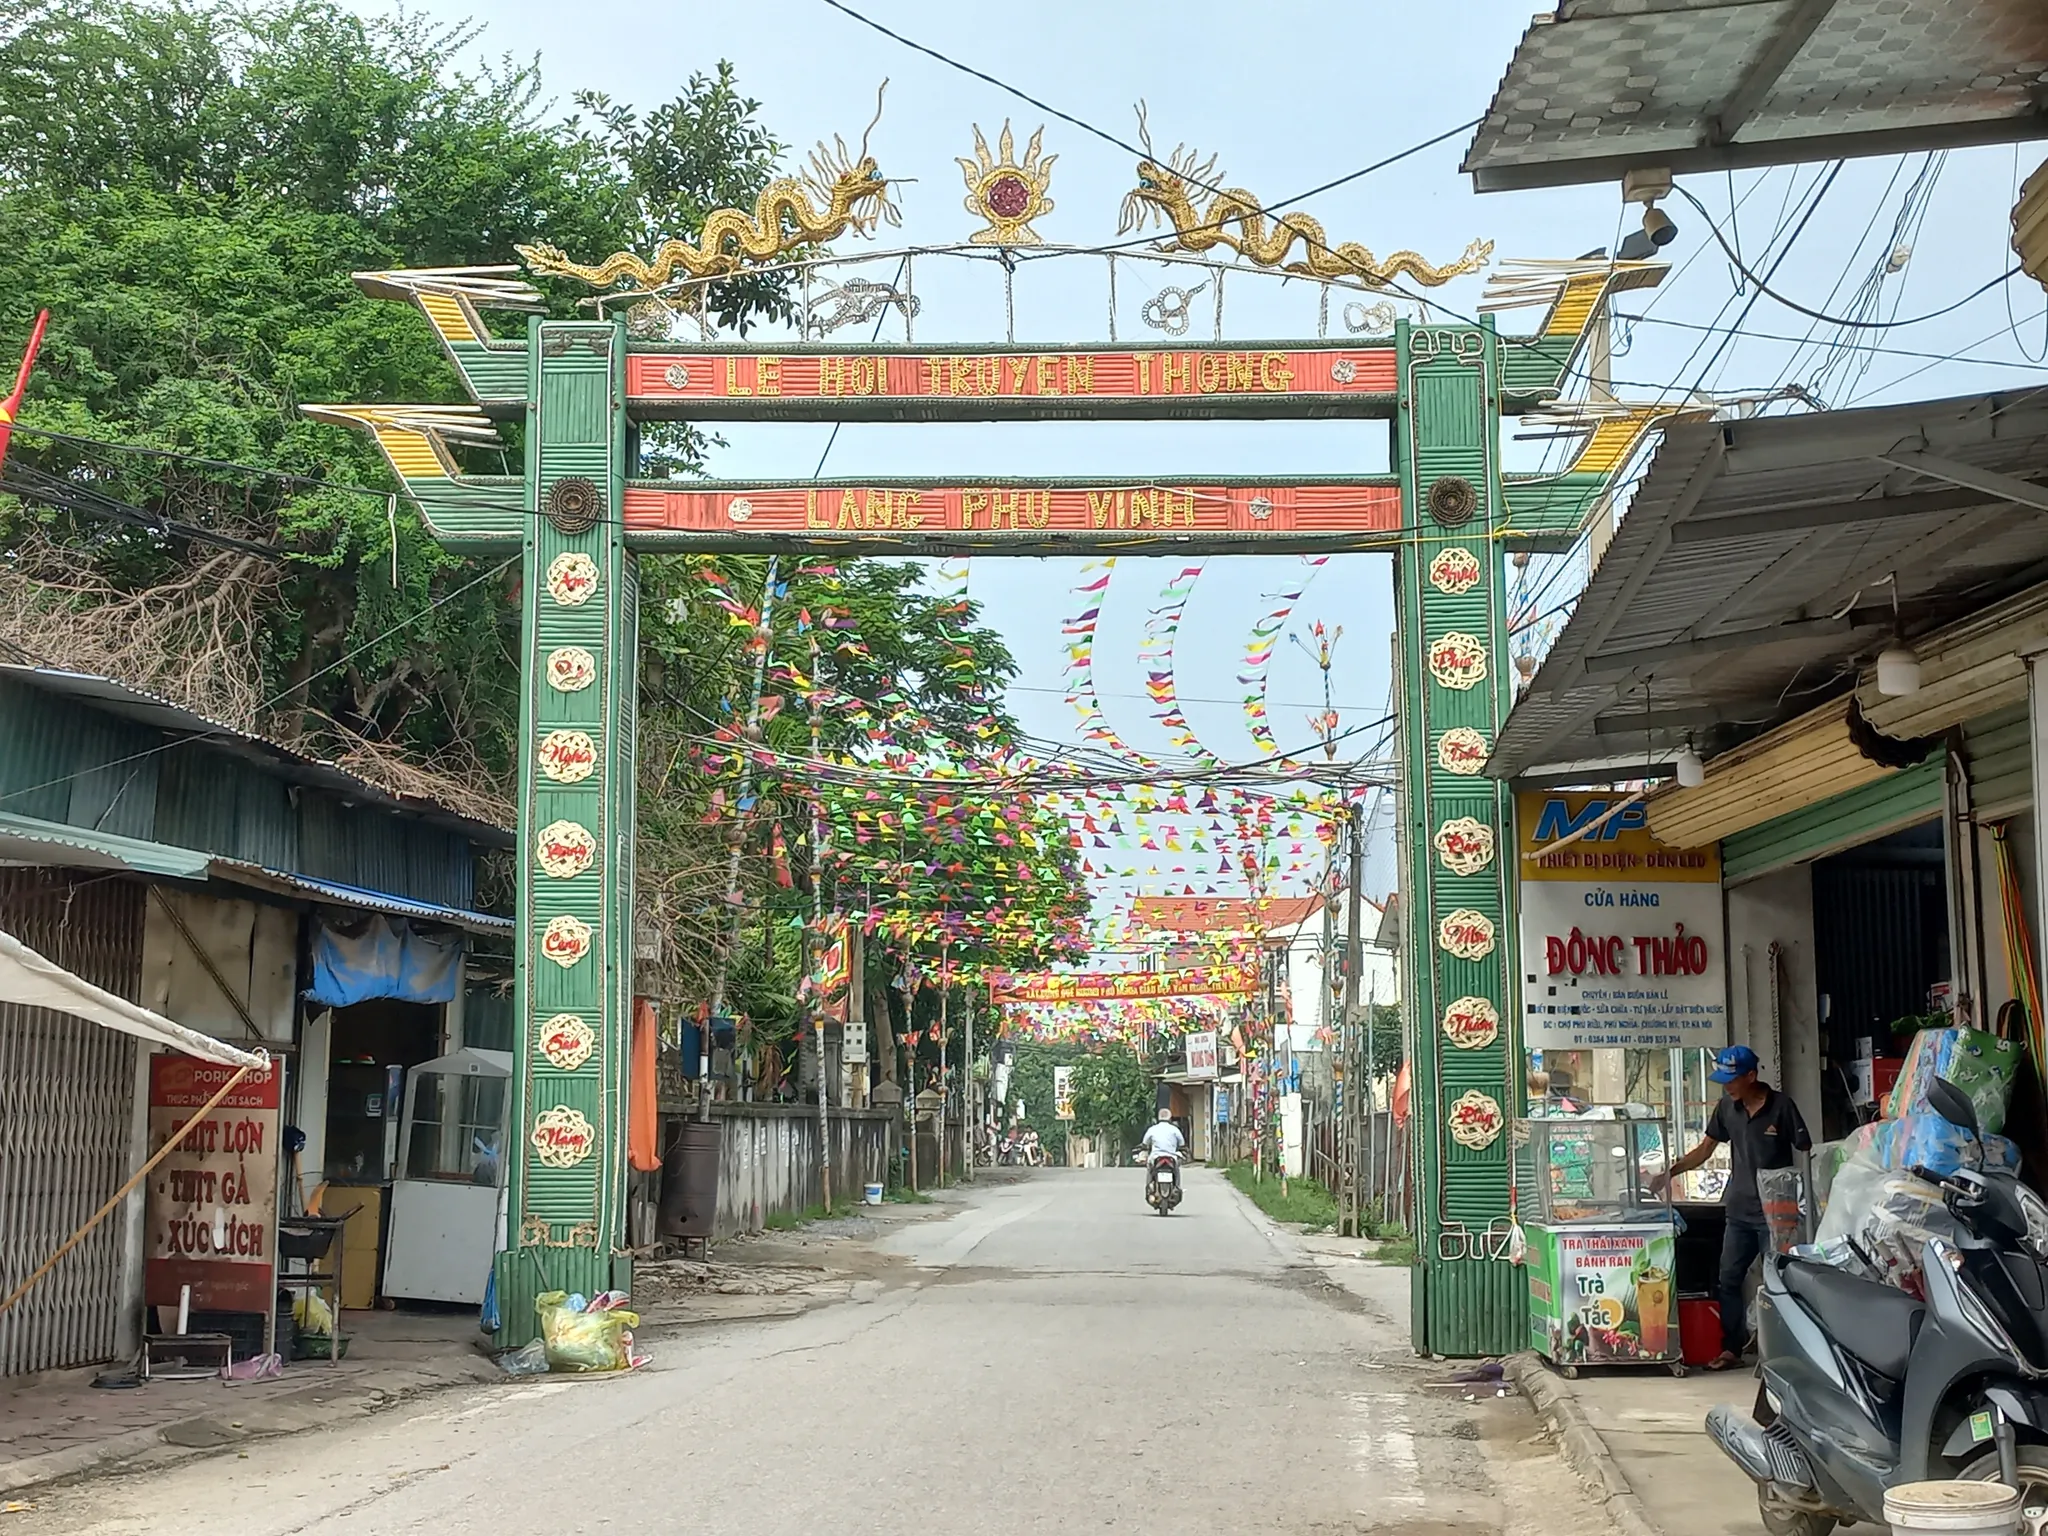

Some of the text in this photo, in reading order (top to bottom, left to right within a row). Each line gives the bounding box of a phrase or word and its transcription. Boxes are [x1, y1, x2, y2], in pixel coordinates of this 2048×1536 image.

[962, 487, 1050, 529] PHU
[1086, 487, 1194, 529] VINH
[1584, 887, 1660, 907] CỬA HÀNG
[1630, 922, 1708, 977] THẢO
[194, 1070, 231, 1083] PORK
[223, 1116, 264, 1161] LỢN
[170, 1164, 250, 1211] THỊT GÀ
[168, 1212, 209, 1253] XÚC
[1562, 1236, 1583, 1250] TRÀ
[1613, 1237, 1643, 1249] XANH
[1576, 1255, 1632, 1268] BÁNH RÁN
[1578, 1273, 1605, 1295] Trà
[1581, 1300, 1611, 1326] Tắc
